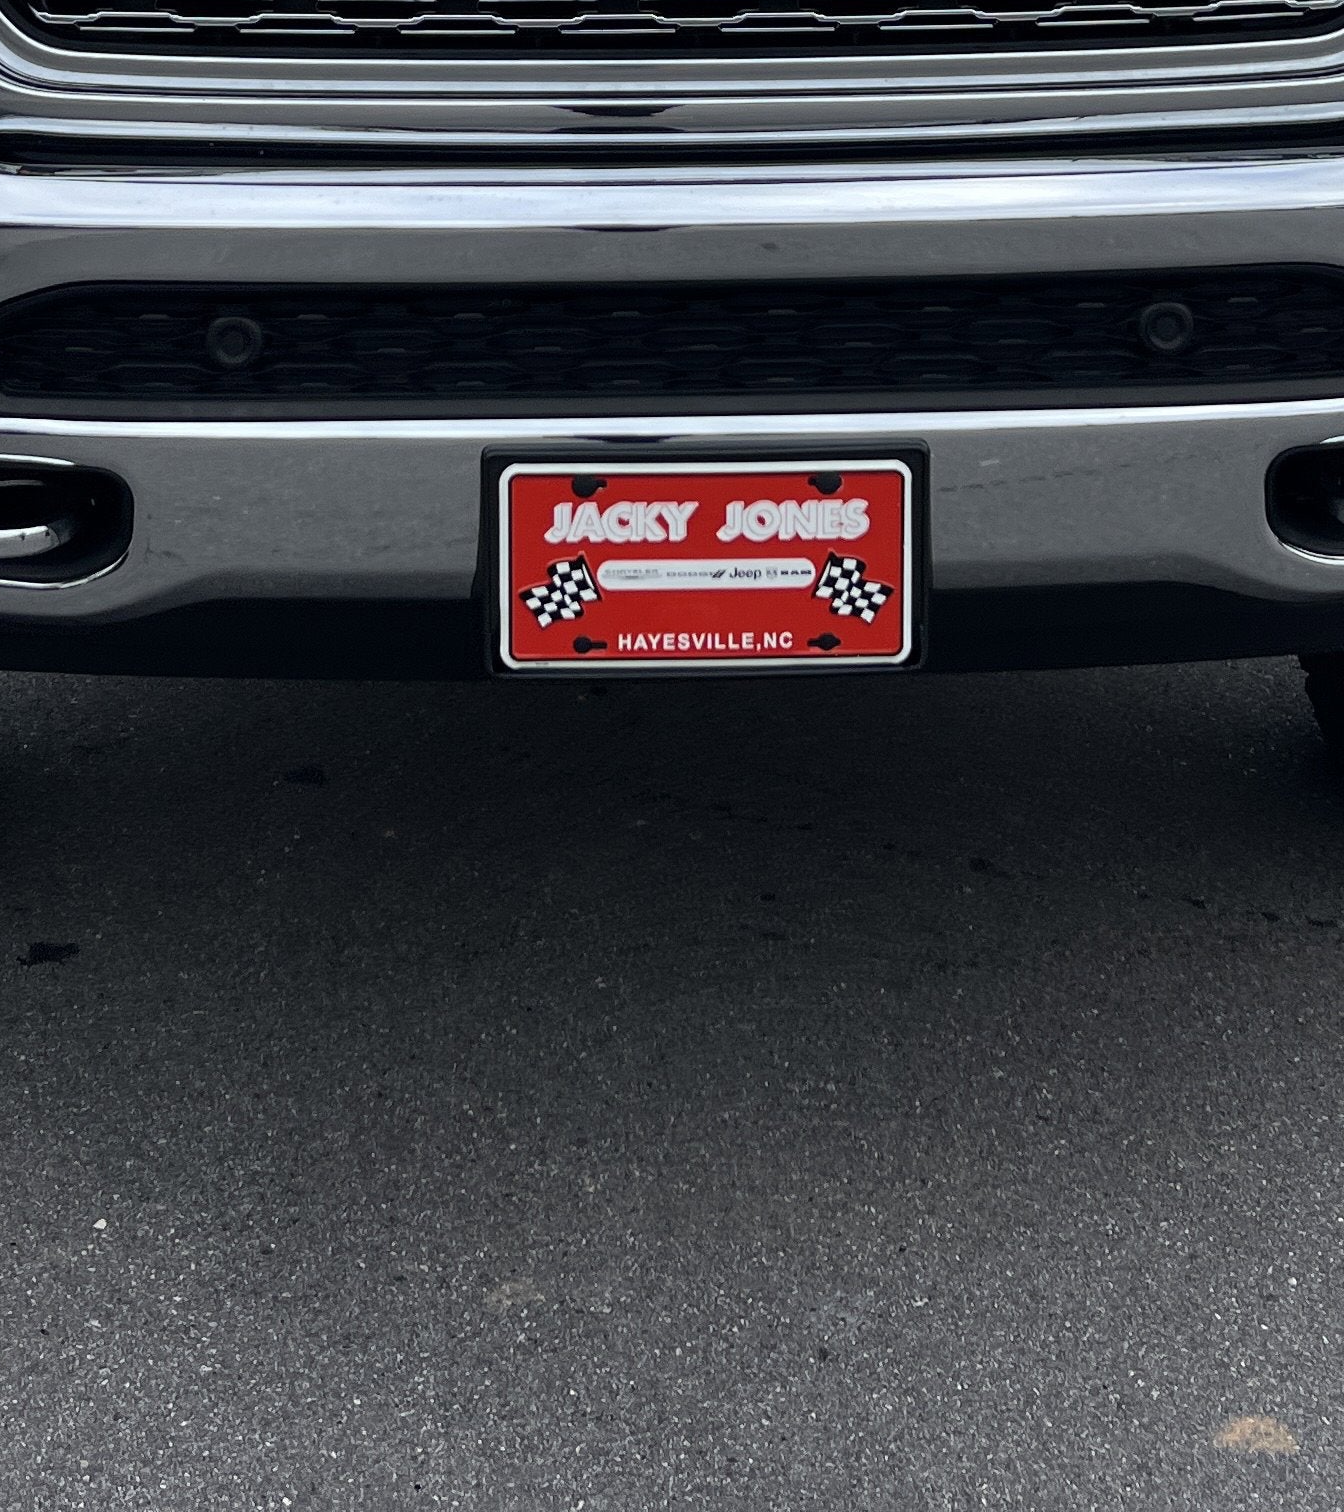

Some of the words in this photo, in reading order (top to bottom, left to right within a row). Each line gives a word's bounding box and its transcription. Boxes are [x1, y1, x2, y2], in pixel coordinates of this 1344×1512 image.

[544, 501, 699, 544] JACKY
[716, 499, 870, 542] JONES
[729, 567, 762, 580] Jeep
